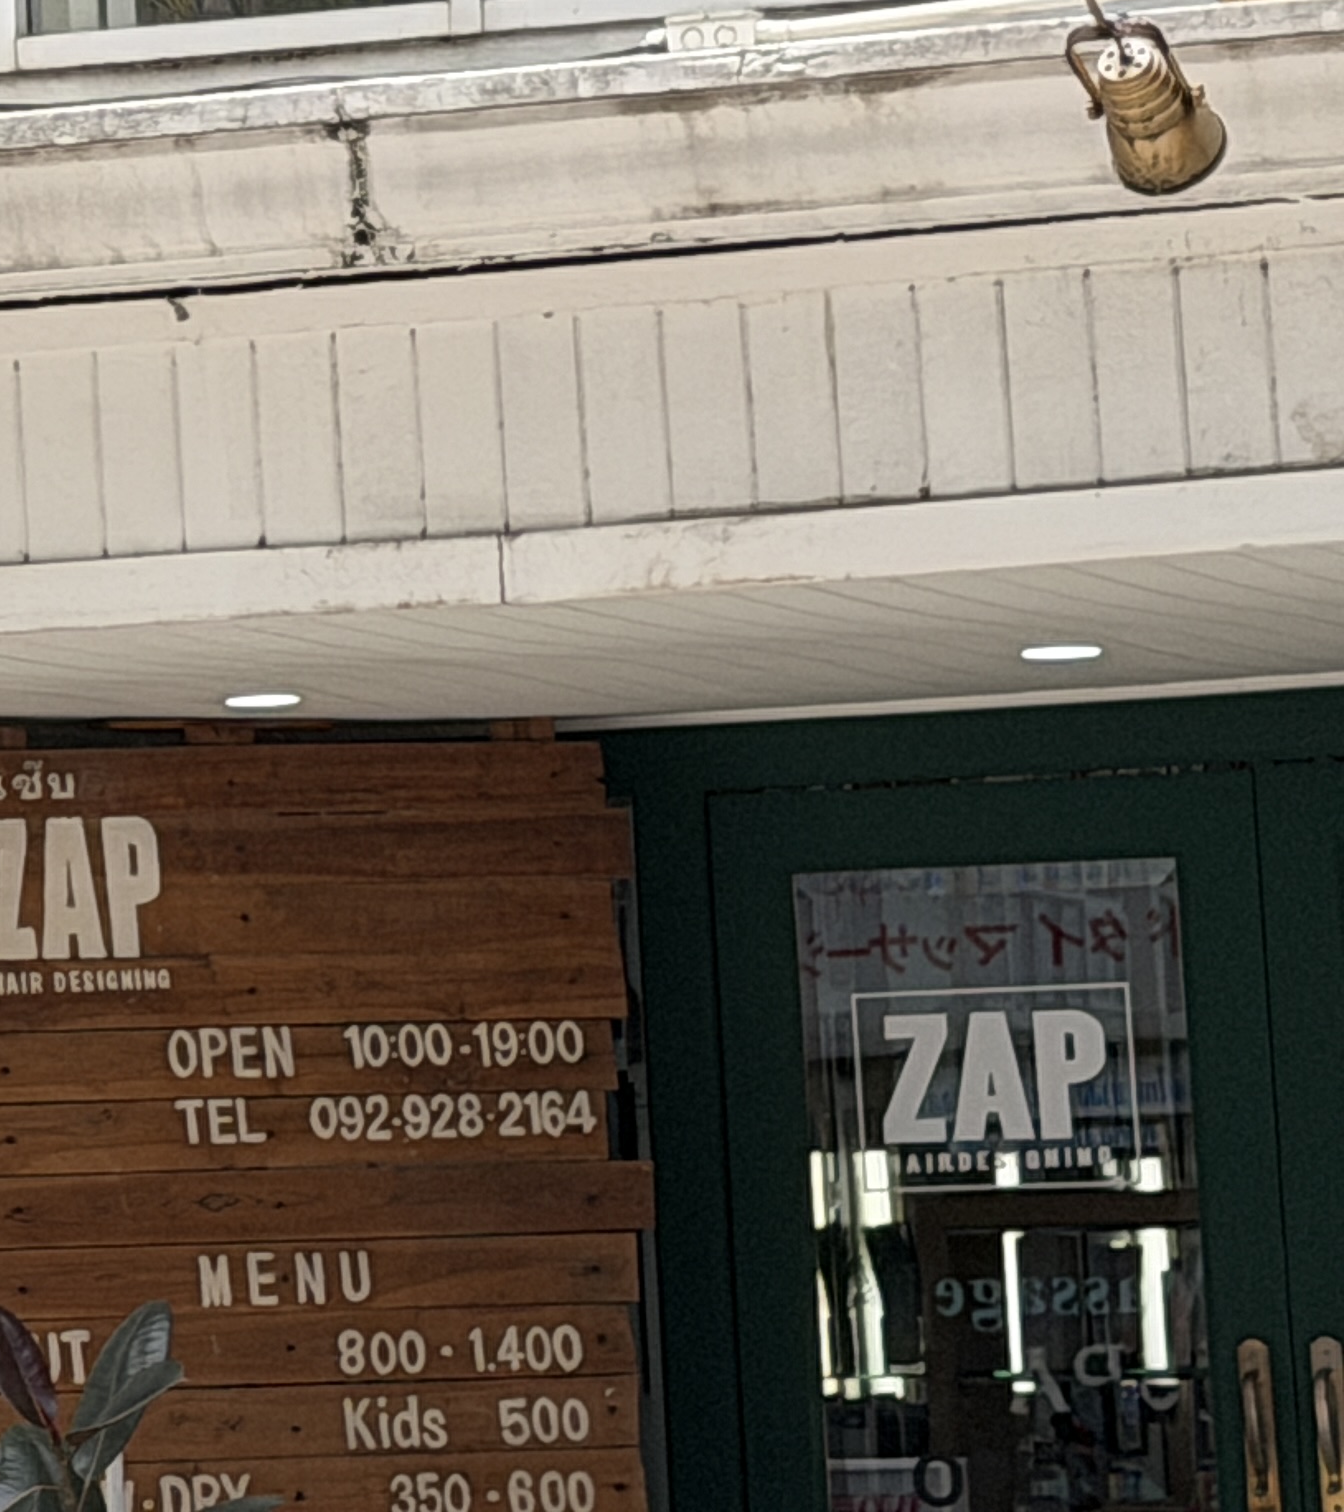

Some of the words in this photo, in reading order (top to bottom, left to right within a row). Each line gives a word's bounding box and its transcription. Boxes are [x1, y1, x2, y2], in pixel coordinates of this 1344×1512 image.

[53, 968, 171, 993] DESIGNING
[167, 1026, 296, 1079] OPEN
[883, 1009, 1107, 1144] ZAP
[174, 1097, 268, 1144] TEL
[197, 1250, 372, 1309] MENU
[337, 1329, 426, 1376] 800
[343, 1394, 448, 1451] Kids
[498, 1396, 590, 1446] 500
[389, 1472, 471, 1512] 350
[507, 1469, 595, 1512] 600
